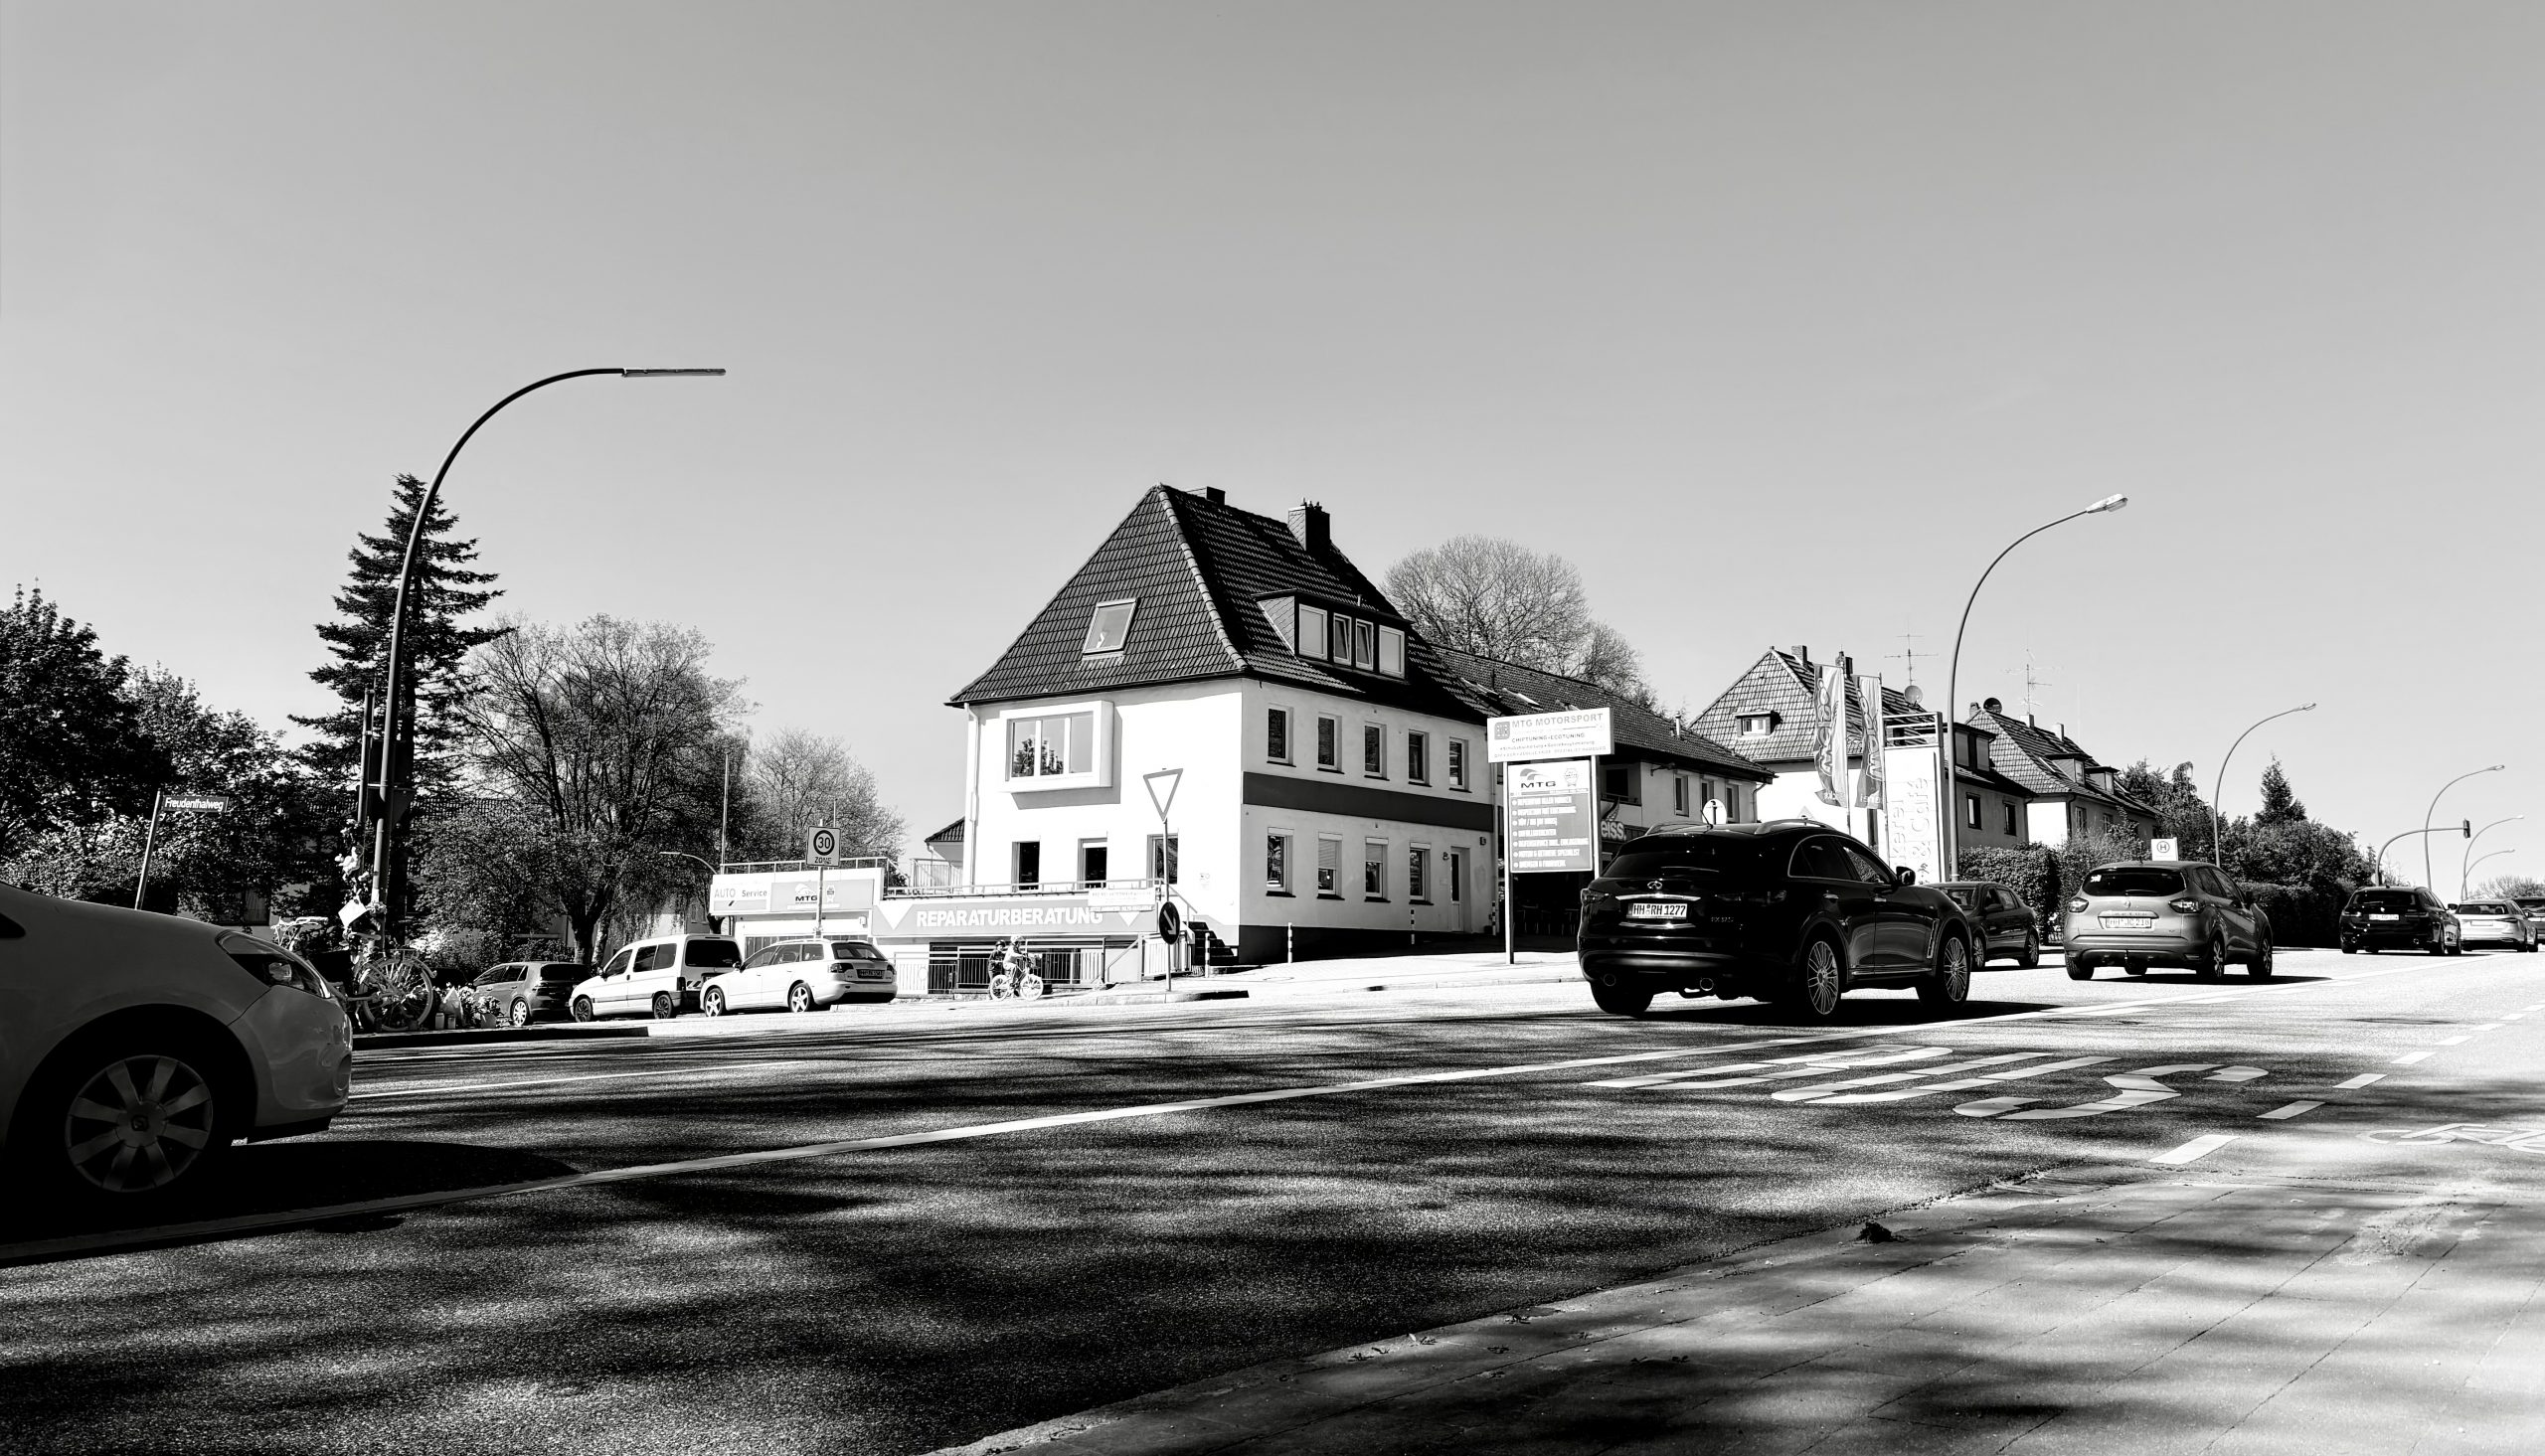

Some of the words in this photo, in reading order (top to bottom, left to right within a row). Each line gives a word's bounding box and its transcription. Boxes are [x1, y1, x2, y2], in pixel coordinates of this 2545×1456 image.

[1512, 719, 1533, 728] MTG
[1535, 713, 1604, 727] MOTORSPORT
[164, 797, 224, 812] Freudenthalweg
[1601, 820, 1627, 841] eiss.
[1890, 799, 1906, 867] kerei
[817, 836, 831, 849] 30
[814, 856, 832, 865] ZONE
[714, 888, 736, 898] AUTO
[916, 906, 1103, 927] REPARATURBERATUNG
[1633, 904, 1645, 915] HH
[1651, 904, 1663, 915] RH
[1664, 905, 1686, 915] 1277
[1579, 1045, 2269, 1120] BUS
